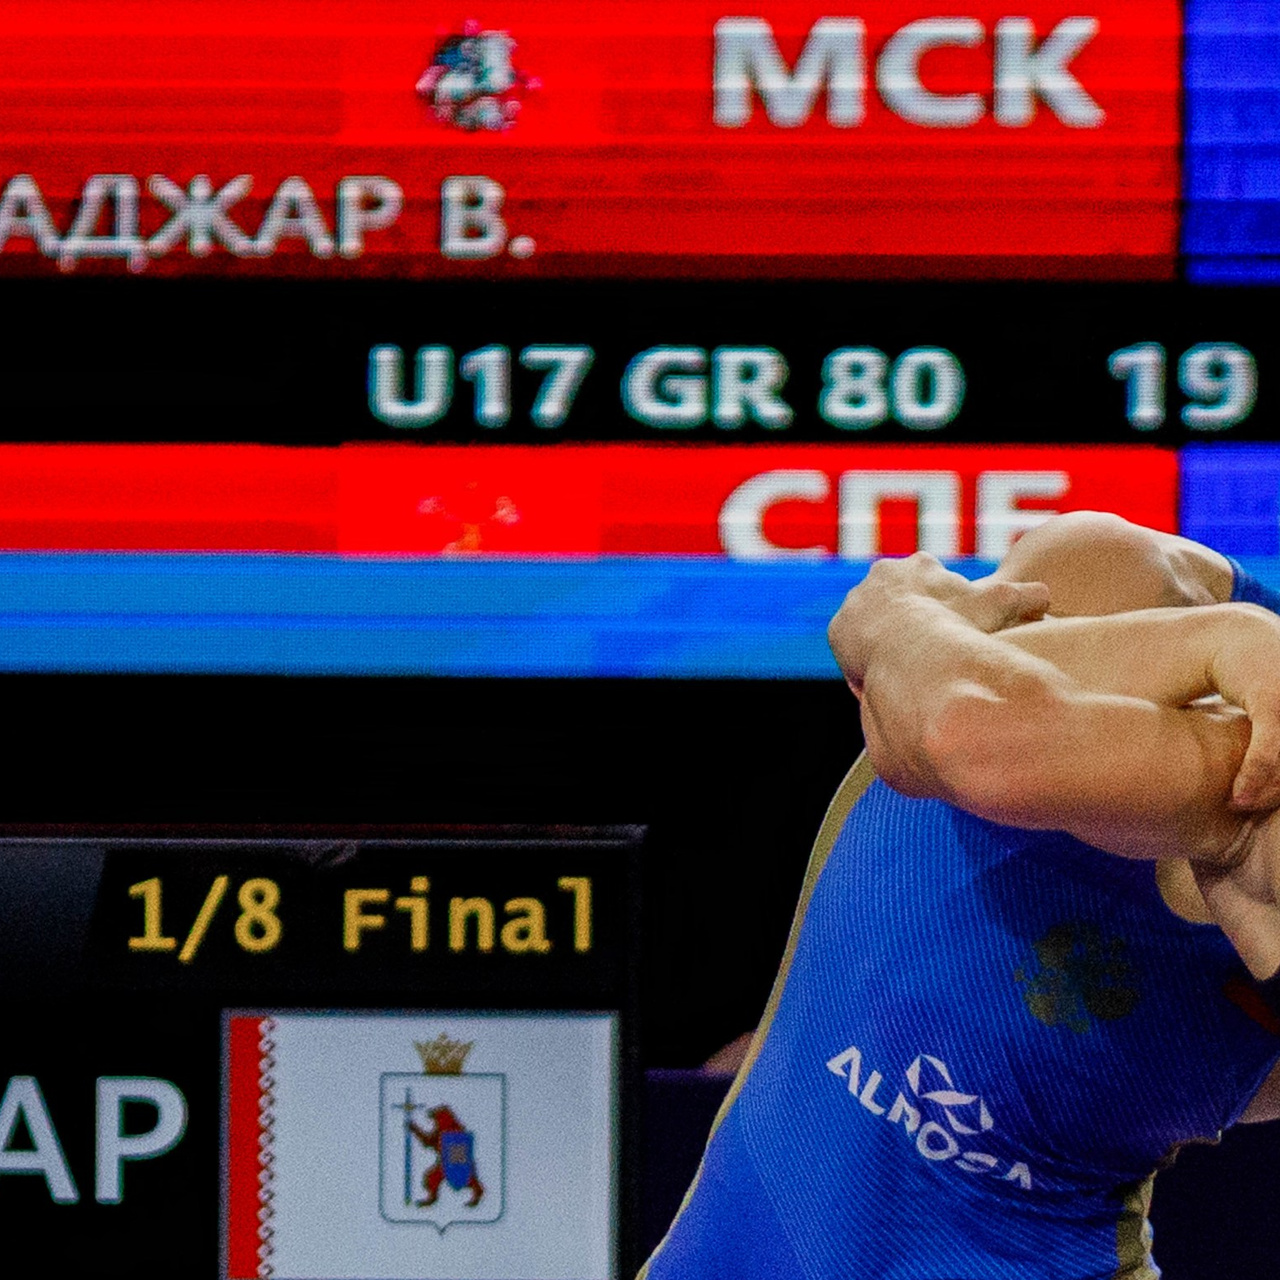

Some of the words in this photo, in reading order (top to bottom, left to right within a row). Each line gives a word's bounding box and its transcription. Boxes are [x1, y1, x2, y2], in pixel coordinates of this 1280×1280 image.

[712, 16, 1106, 128] МСК
[440, 176, 537, 259] В.
[367, 343, 594, 429] U17
[620, 345, 793, 429] GR
[818, 345, 967, 430] 80
[1107, 342, 1258, 430] 19
[127, 875, 283, 962] 1/8
[341, 876, 594, 953] Final
[826, 1045, 1032, 1190] ALROSA
